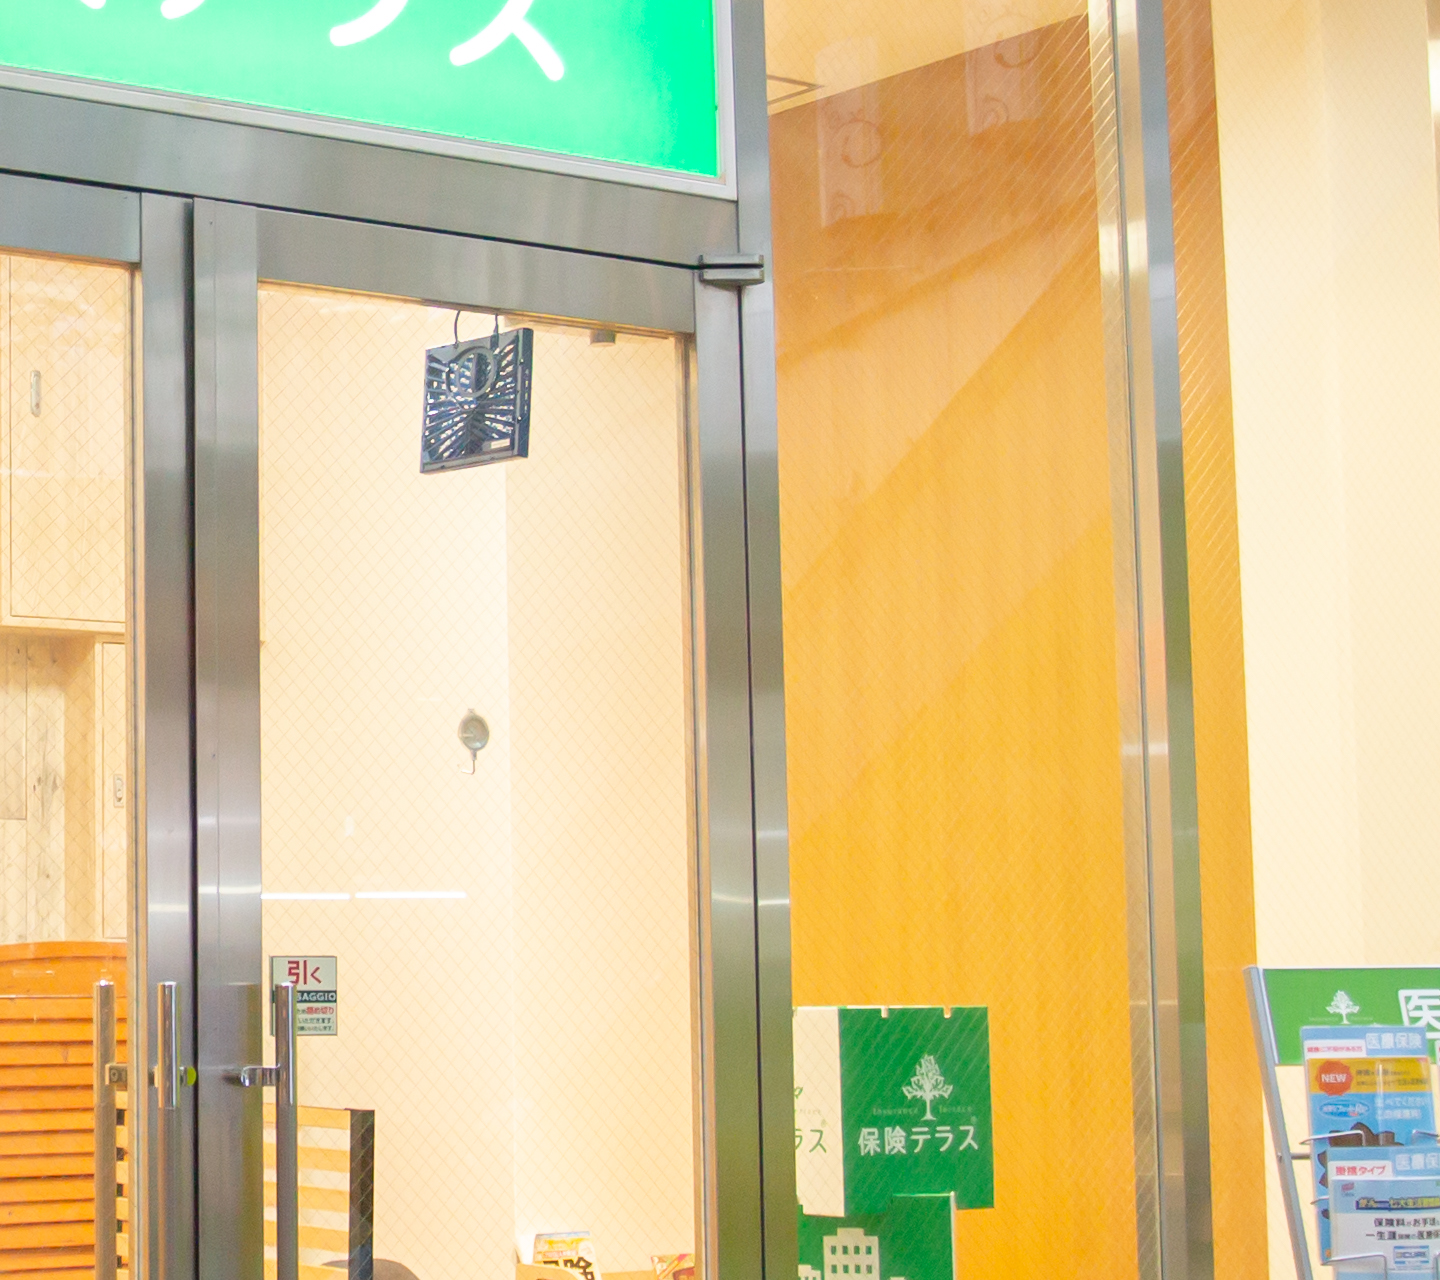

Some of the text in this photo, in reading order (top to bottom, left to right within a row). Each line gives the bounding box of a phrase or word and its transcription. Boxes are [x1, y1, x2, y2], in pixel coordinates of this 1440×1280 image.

[287, 960, 322, 985] 引く
[1365, 1033, 1422, 1049] 医療保険
[1321, 1074, 1347, 1083] NEW
[858, 1125, 979, 1156] 保険テラス
